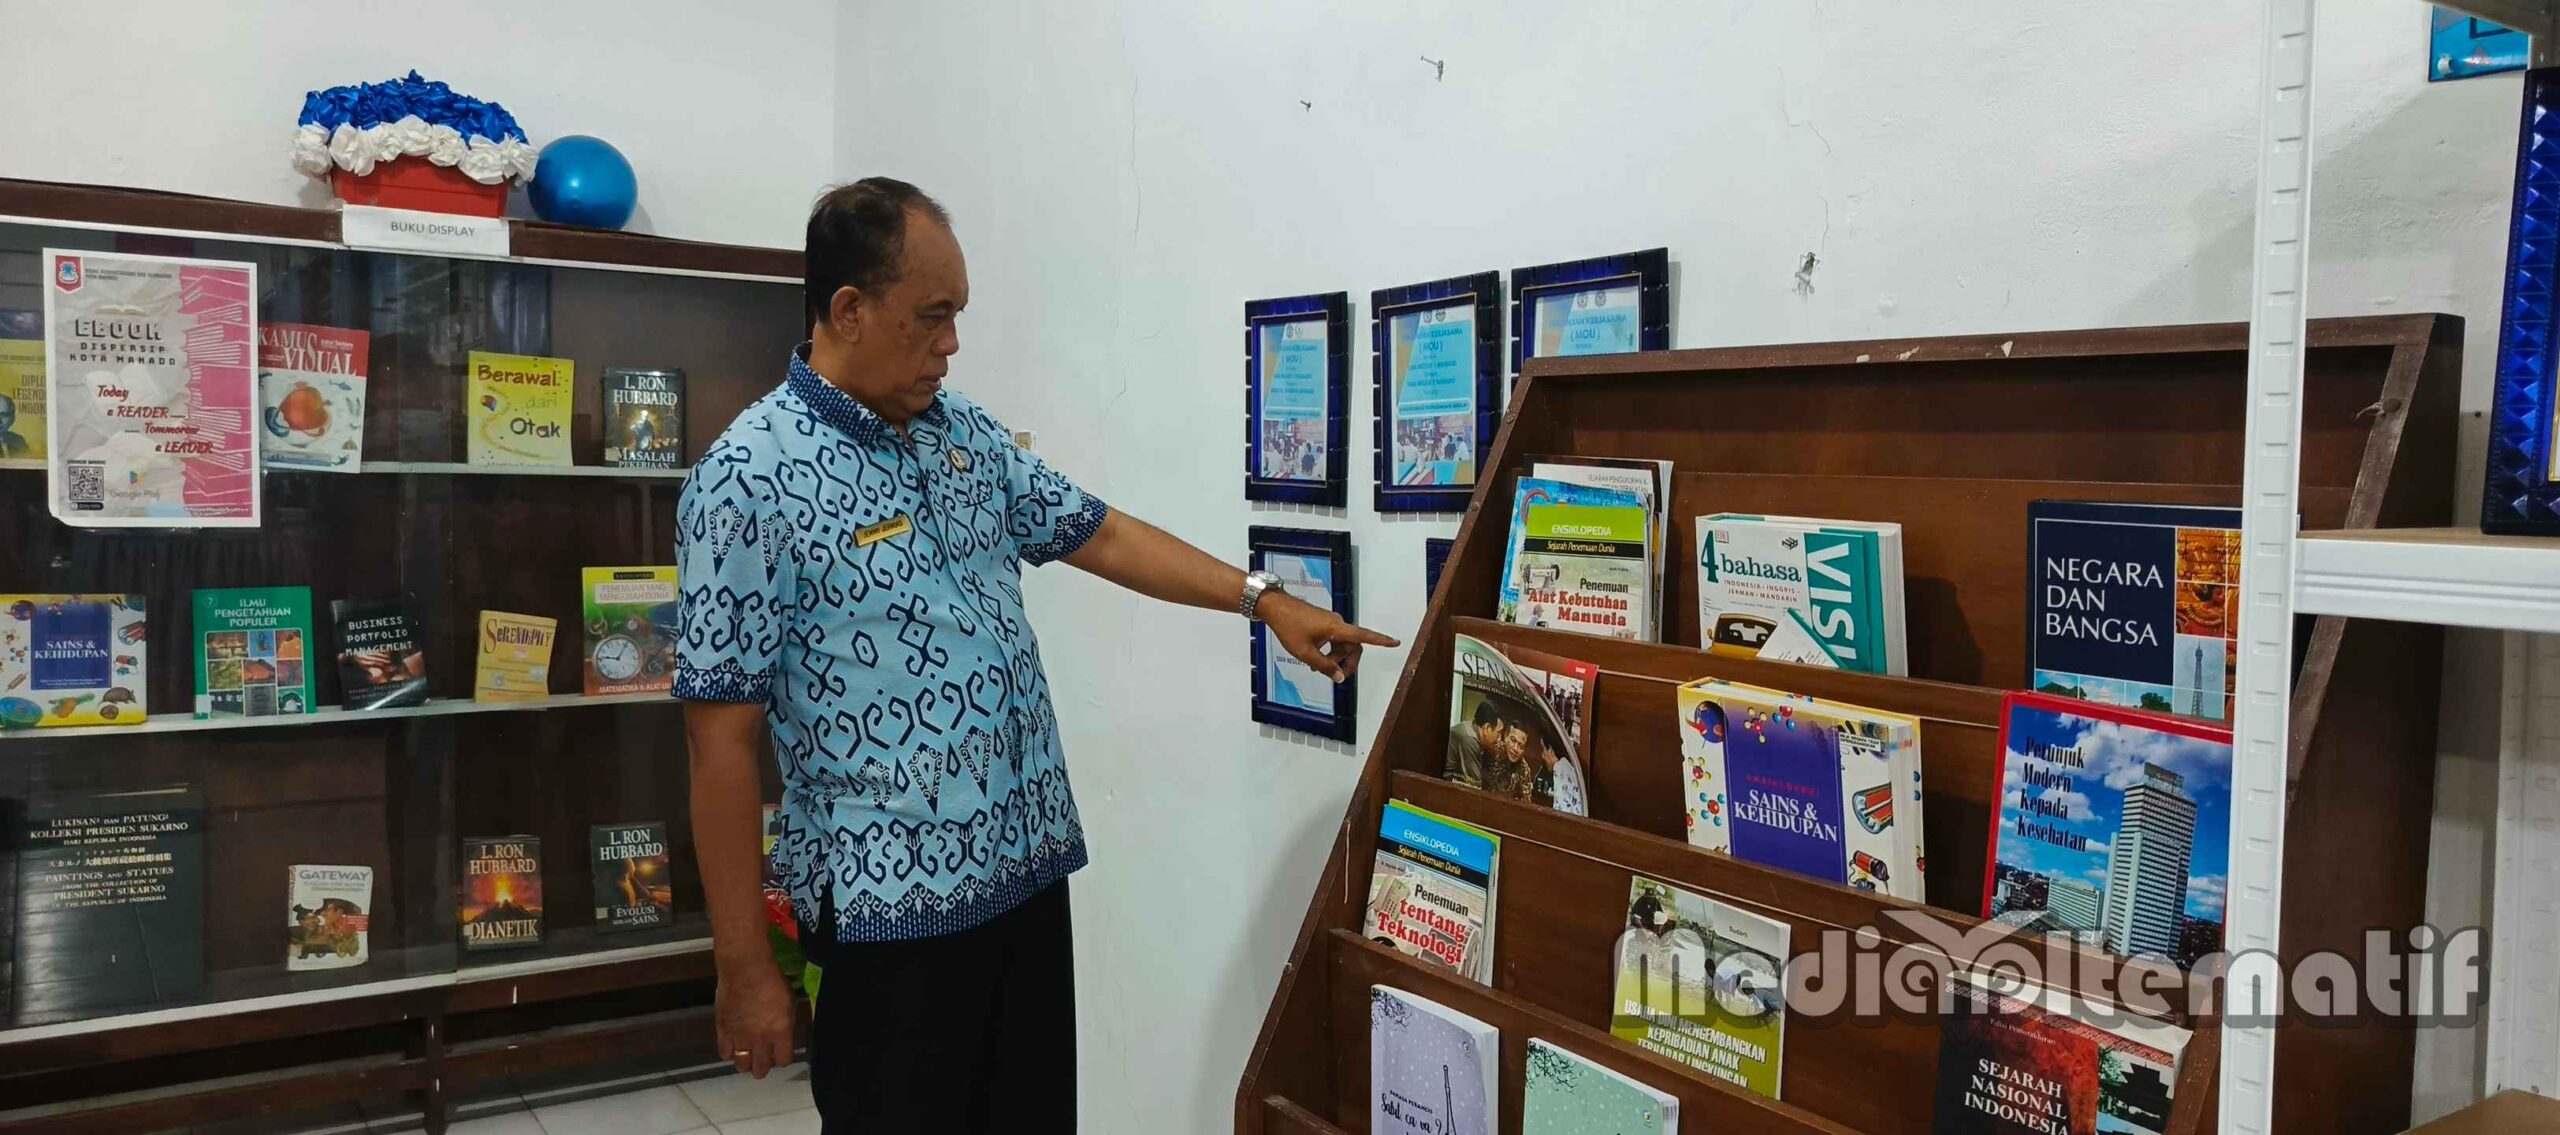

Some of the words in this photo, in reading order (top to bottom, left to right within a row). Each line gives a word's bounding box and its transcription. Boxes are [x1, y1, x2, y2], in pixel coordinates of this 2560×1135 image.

[391, 221, 425, 233] BUKU
[429, 224, 475, 236] DISPLAY
[75, 318, 162, 341] EBOOK
[259, 327, 318, 349] KAMUS
[80, 342, 165, 353] DISPERSIP
[70, 353, 107, 362] KOTA
[116, 355, 176, 365] MANADO
[283, 345, 357, 376] VISUAL
[21, 375, 46, 387] DIPLO
[478, 364, 557, 387] Berawal
[624, 375, 635, 389] L.
[638, 376, 666, 391] RON
[12, 387, 47, 400] LEGEND
[98, 385, 129, 399] Today
[613, 389, 678, 406] HUBBARD
[18, 402, 47, 414] INDON
[117, 406, 169, 418] READER
[510, 417, 560, 438] Otak
[165, 441, 213, 454] LEADER
[619, 448, 676, 462] MASALAH
[1551, 525, 1612, 536] ENSIKLOPEDIA
[1547, 541, 1567, 551] Sejarah
[1568, 542, 1598, 552] Penemuan
[1598, 543, 1616, 553] Dunia
[1701, 530, 1719, 583] 4
[1720, 553, 1802, 582] bahasa
[2047, 557, 2164, 588] NEGARA
[1580, 578, 1629, 593] Penemuan
[1724, 580, 1760, 589] INDONESIA
[1766, 585, 1795, 593] INGGRIS
[239, 598, 266, 607] ILMU
[1528, 588, 1556, 603] Alat
[1558, 591, 1628, 610] Kebutuhan
[1728, 588, 1754, 597] JERMAN
[1760, 593, 1798, 602] MANDARIN
[2047, 585, 2105, 612] DAN
[214, 607, 291, 618] PENGETAHUAN
[1557, 607, 1627, 627] Manusia
[229, 617, 278, 627] POPULER
[348, 616, 403, 630] BUSINESS
[2046, 613, 2158, 647] BANGSA
[346, 628, 408, 643] PORTFOLIO
[46, 641, 83, 649] SAINS
[86, 640, 96, 649] &
[345, 641, 413, 656] MANAGEMENT
[34, 649, 108, 659] KEHIDUPAN
[2025, 736, 2085, 768] Petunjuk
[2022, 763, 2071, 793] Modern
[1749, 789, 1799, 817] SAINS
[1803, 802, 1818, 820] &
[2020, 788, 2068, 820] Kepada
[1734, 801, 1838, 843] KEHIDUPAN
[30, 829, 82, 839] KOLLEKSI
[86, 825, 136, 836] PRESIDEN
[140, 823, 188, 832] SUKARNO
[610, 832, 621, 845] L.
[623, 829, 650, 844] RON
[2017, 815, 2087, 852] Kesehatan
[1404, 829, 1460, 857] ENSIKLOPEDIA
[481, 845, 493, 859] L.
[495, 844, 525, 859] RON
[600, 843, 663, 860] HUBBARD
[470, 858, 537, 875] HUBBARD
[1398, 845, 1418, 860] Sejarah
[1417, 850, 1445, 870] Penemuan
[1446, 861, 1461, 875] Dunia
[45, 871, 103, 882] PAINTINGS
[126, 867, 174, 877] STATUES
[299, 870, 369, 881] GATEWAY
[54, 888, 113, 900] PRESIDENT
[117, 885, 166, 895] SUKARNO
[1415, 884, 1469, 917] Penemuan
[616, 906, 655, 918] EVOLUSI
[632, 914, 660, 925] SAINS
[1400, 898, 1467, 943] tentang
[471, 919, 538, 940] DIANETIK
[1378, 911, 1465, 964] Teknologi
[1624, 999, 1656, 1025] USAHA
[1657, 1010, 1677, 1030] DINI
[1678, 1017, 1767, 1063] MENGEMBANGKAN
[1648, 1026, 1710, 1060] KEPRIBADIAN
[1711, 1049, 1740, 1071] ANAK
[1978, 1058, 2063, 1098] SEJARAH
[1971, 1075, 2068, 1120] NASIONAL
[1964, 1092, 2070, 1135] INDONESIA
